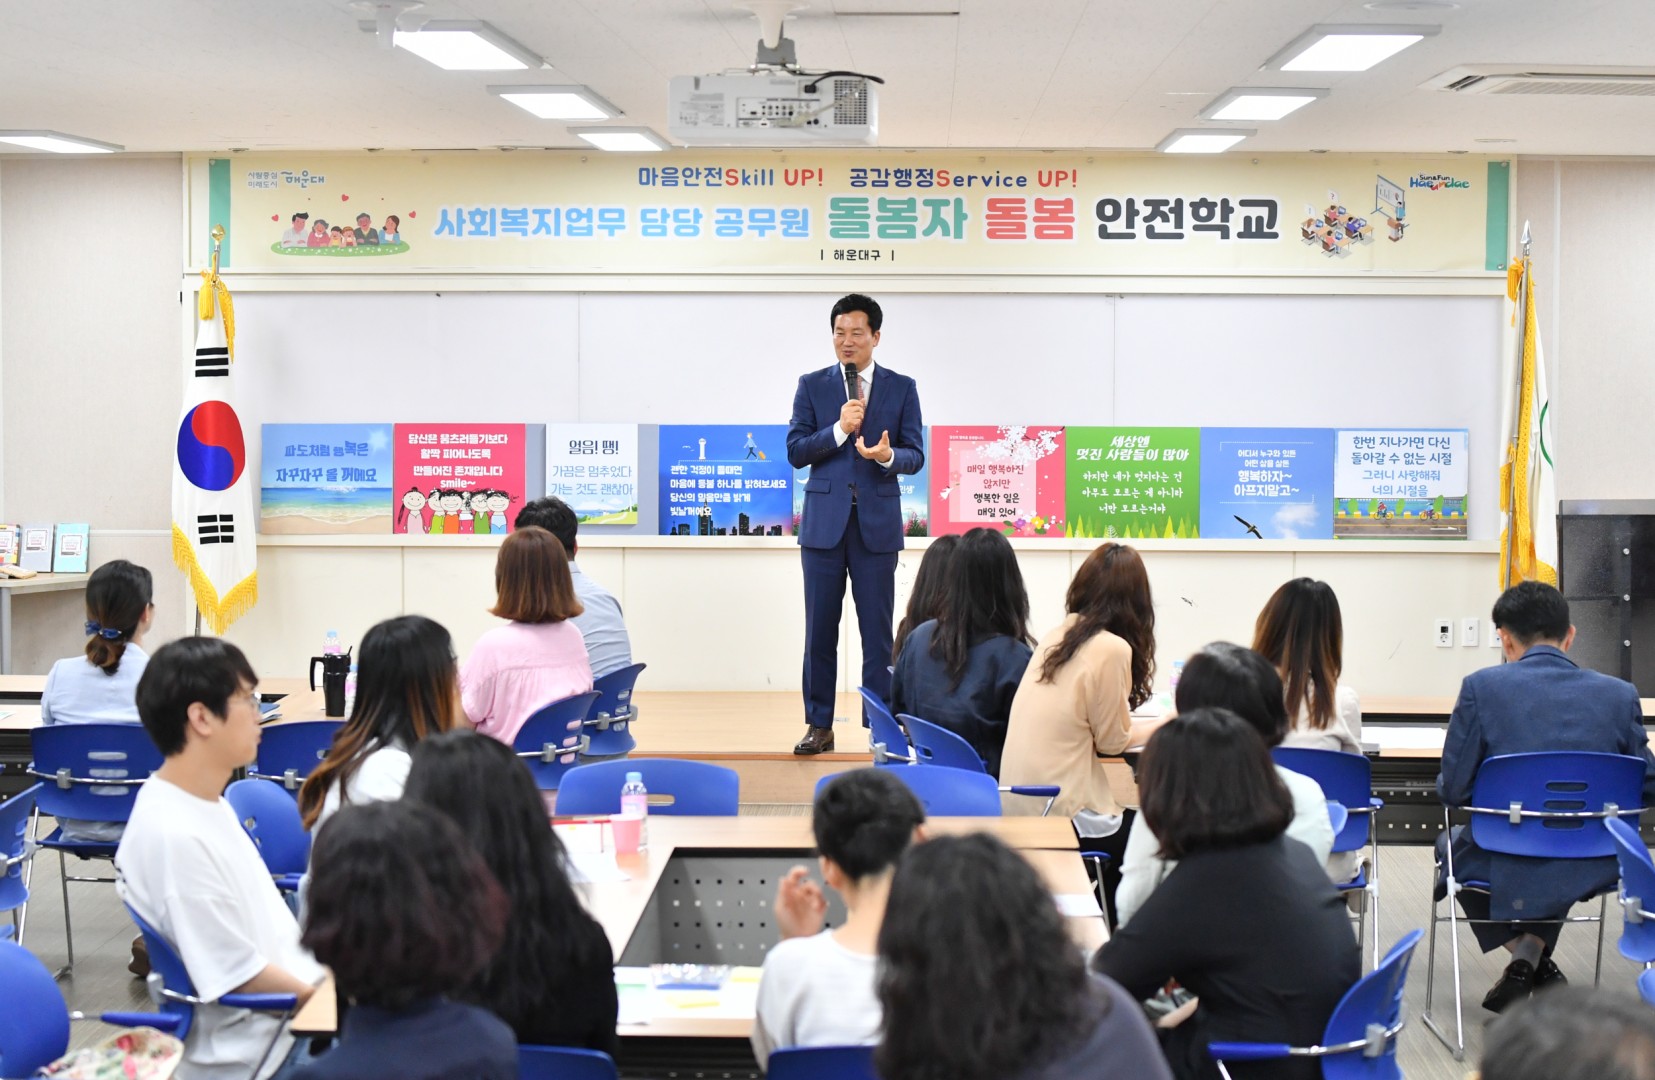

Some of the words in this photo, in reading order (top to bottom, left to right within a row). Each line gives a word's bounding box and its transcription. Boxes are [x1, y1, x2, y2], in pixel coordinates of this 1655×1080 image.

[247, 171, 278, 180] 사람중심
[280, 170, 325, 188] 해운대
[638, 167, 775, 187] 마음안전Skill
[783, 167, 824, 187] UP!
[849, 167, 1028, 188] 공감행정Service
[1037, 167, 1078, 188] UP!
[247, 181, 278, 189] 미래도시
[434, 207, 627, 239] 사회복지업무
[640, 207, 702, 238] 담당
[714, 207, 811, 238] 공무원
[828, 196, 969, 240] 돌봄자
[984, 196, 1076, 240] 돌봄
[1095, 197, 1280, 241] 안전학교
[833, 248, 882, 262] 해운대구
[408, 434, 437, 444] 당신은
[1110, 435, 1150, 448] 세상엔
[1353, 436, 1376, 449] 한번
[1380, 437, 1424, 449] 지나가면
[1428, 437, 1450, 449] 다신
[285, 444, 330, 456] 파도처럼
[569, 440, 598, 455] 얼음!
[602, 440, 619, 455] 땡!
[421, 449, 440, 459] 활짝
[443, 449, 491, 459] 피어나도록
[1076, 448, 1102, 461] 멋진
[1105, 449, 1159, 461] 사람들이
[1162, 449, 1189, 461] 많아
[1351, 452, 1386, 465] 돌아갈
[1389, 453, 1400, 464] 수
[1404, 453, 1426, 465] 없는
[1430, 453, 1452, 465] 시절
[1245, 460, 1258, 468] 어떤
[276, 467, 323, 482] 자꾸자꾸
[326, 468, 337, 482] 올
[414, 466, 452, 476] 만들어진
[455, 466, 503, 476] 존재입니다
[553, 466, 585, 478] 가끔은
[589, 466, 632, 478] 멈추었다
[690, 466, 715, 475] 걱정이
[967, 465, 985, 475] 매일
[988, 465, 1024, 475] 행복하진
[1083, 471, 1109, 482] 하지만
[1135, 471, 1169, 482] 멋지다는
[1173, 471, 1182, 482] 건
[1238, 470, 1292, 482] 행복하자~
[1362, 470, 1394, 480] 그러니
[1398, 470, 1441, 482] 사랑해줘
[440, 478, 476, 488] smile~
[670, 479, 696, 488] 마음에
[717, 479, 742, 488] 하나를
[984, 479, 1010, 489] 않지만
[551, 483, 573, 495] 가는
[576, 483, 597, 495] 것도
[600, 483, 633, 495] 괜찮아
[1082, 487, 1109, 498] 아무도
[1113, 488, 1140, 498] 모르는
[1158, 487, 1183, 498] 아니라
[1234, 484, 1299, 496] 아프지말고~
[1373, 485, 1393, 495] 너의
[1397, 485, 1428, 497] 시절을
[670, 493, 695, 502] 당신의
[974, 493, 1000, 503] 행복한
[1004, 493, 1019, 503] 일은
[978, 508, 996, 517] 매일
[999, 508, 1016, 517] 있어
[1099, 503, 1117, 514] 너만
